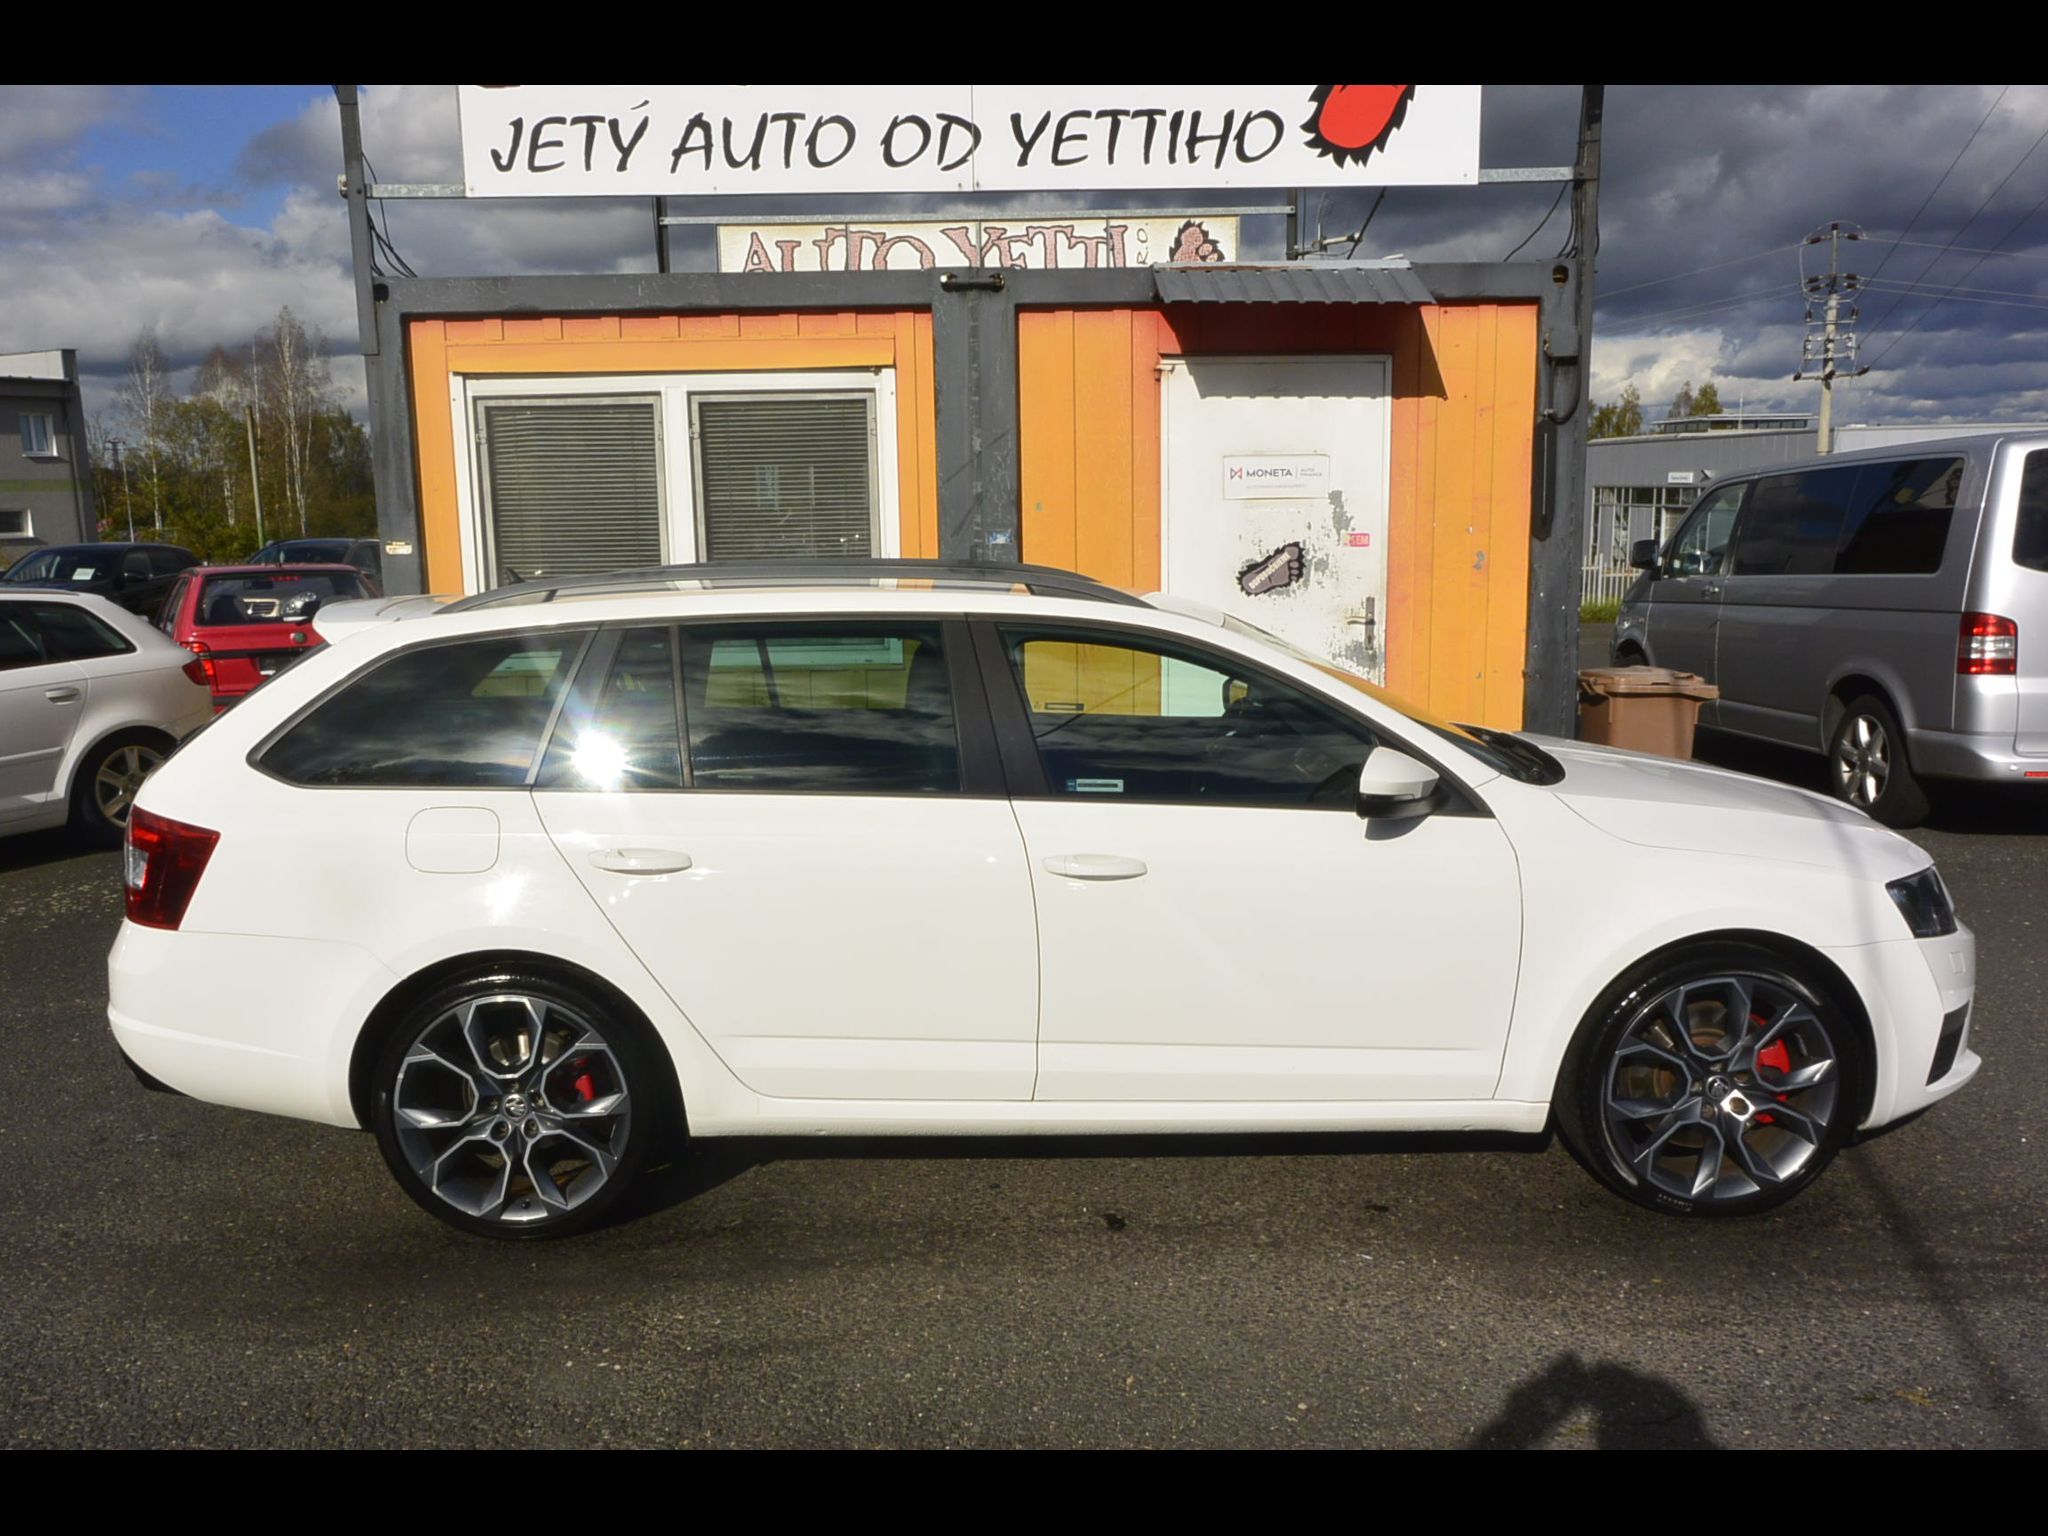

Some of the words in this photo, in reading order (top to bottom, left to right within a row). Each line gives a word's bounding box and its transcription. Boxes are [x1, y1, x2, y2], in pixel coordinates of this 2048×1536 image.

[490, 99, 650, 173] JETÝ
[669, 111, 856, 174] AUTO
[880, 112, 982, 172] OD
[1009, 108, 1285, 169] YETTIHO
[1246, 468, 1293, 478] MONETA
